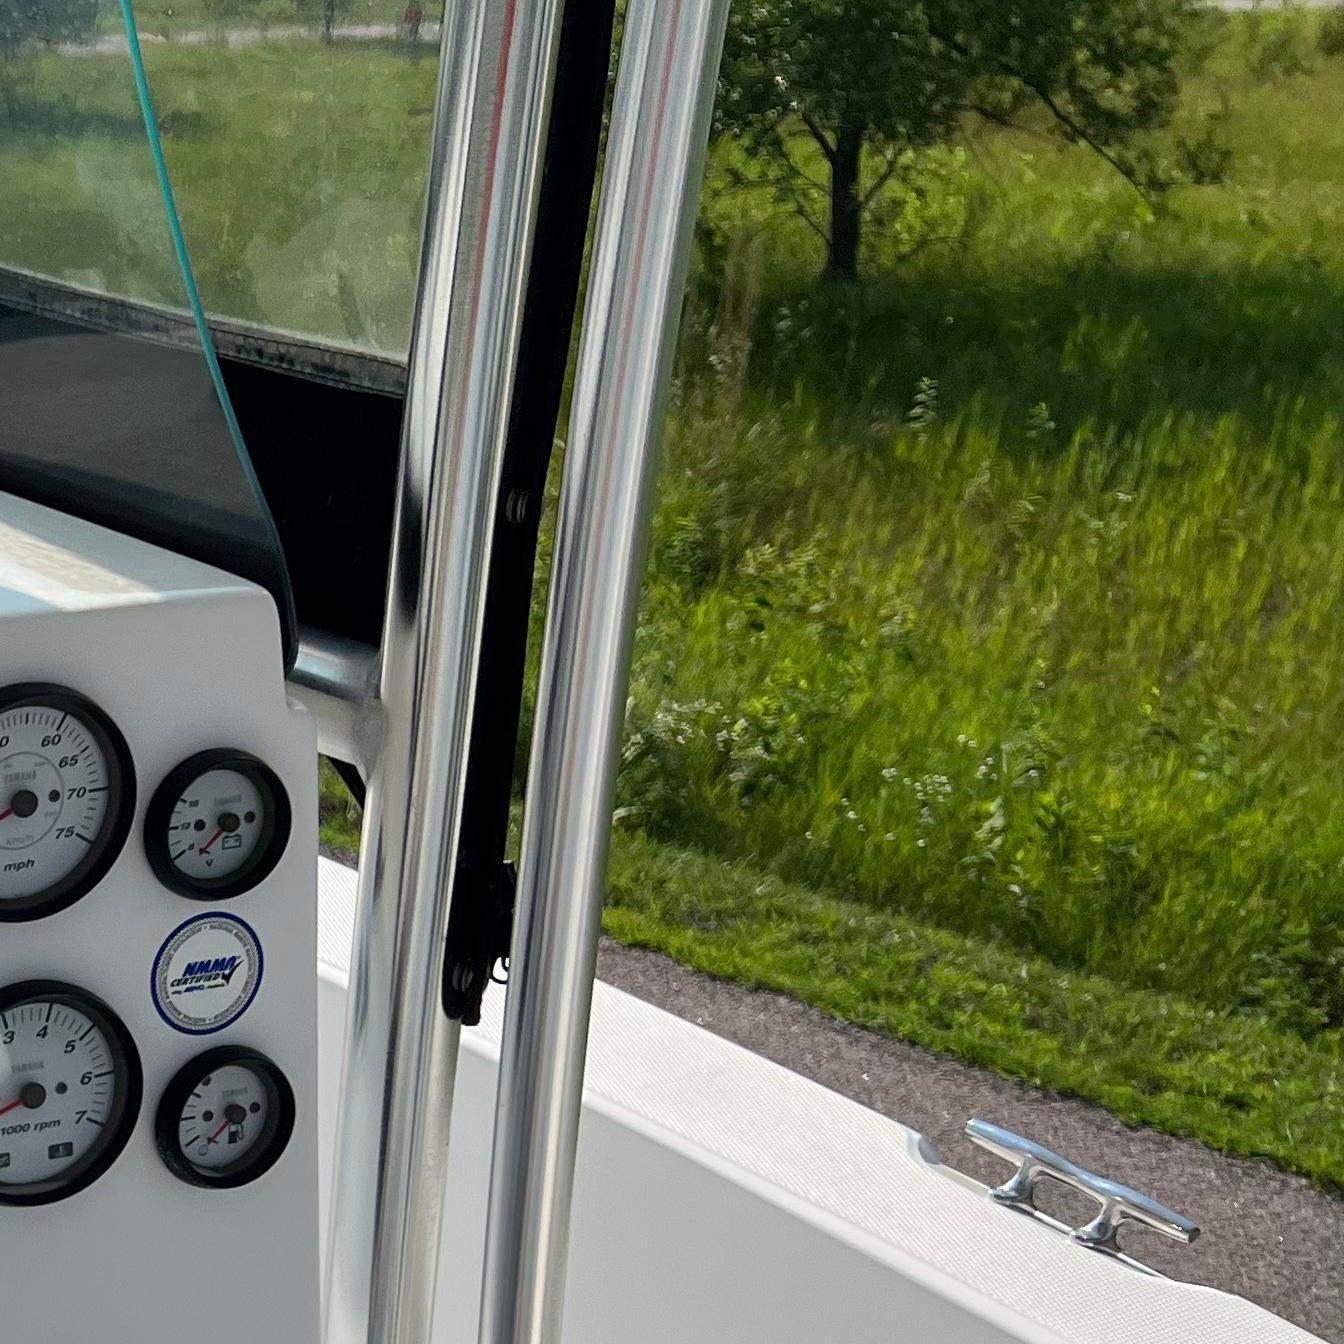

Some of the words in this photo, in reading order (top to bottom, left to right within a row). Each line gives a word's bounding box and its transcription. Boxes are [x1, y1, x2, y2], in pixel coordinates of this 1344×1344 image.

[41, 733, 61, 748] 60
[58, 754, 79, 769] 65
[66, 786, 87, 800] 70
[55, 826, 75, 840] 75
[3, 858, 35, 873] mph
[3, 1031, 15, 1045] 3
[36, 1025, 48, 1039] 4
[64, 1040, 76, 1054] 5
[80, 1071, 93, 1085] 6
[75, 1110, 87, 1125] 7
[34, 1119, 62, 1134] rpm
